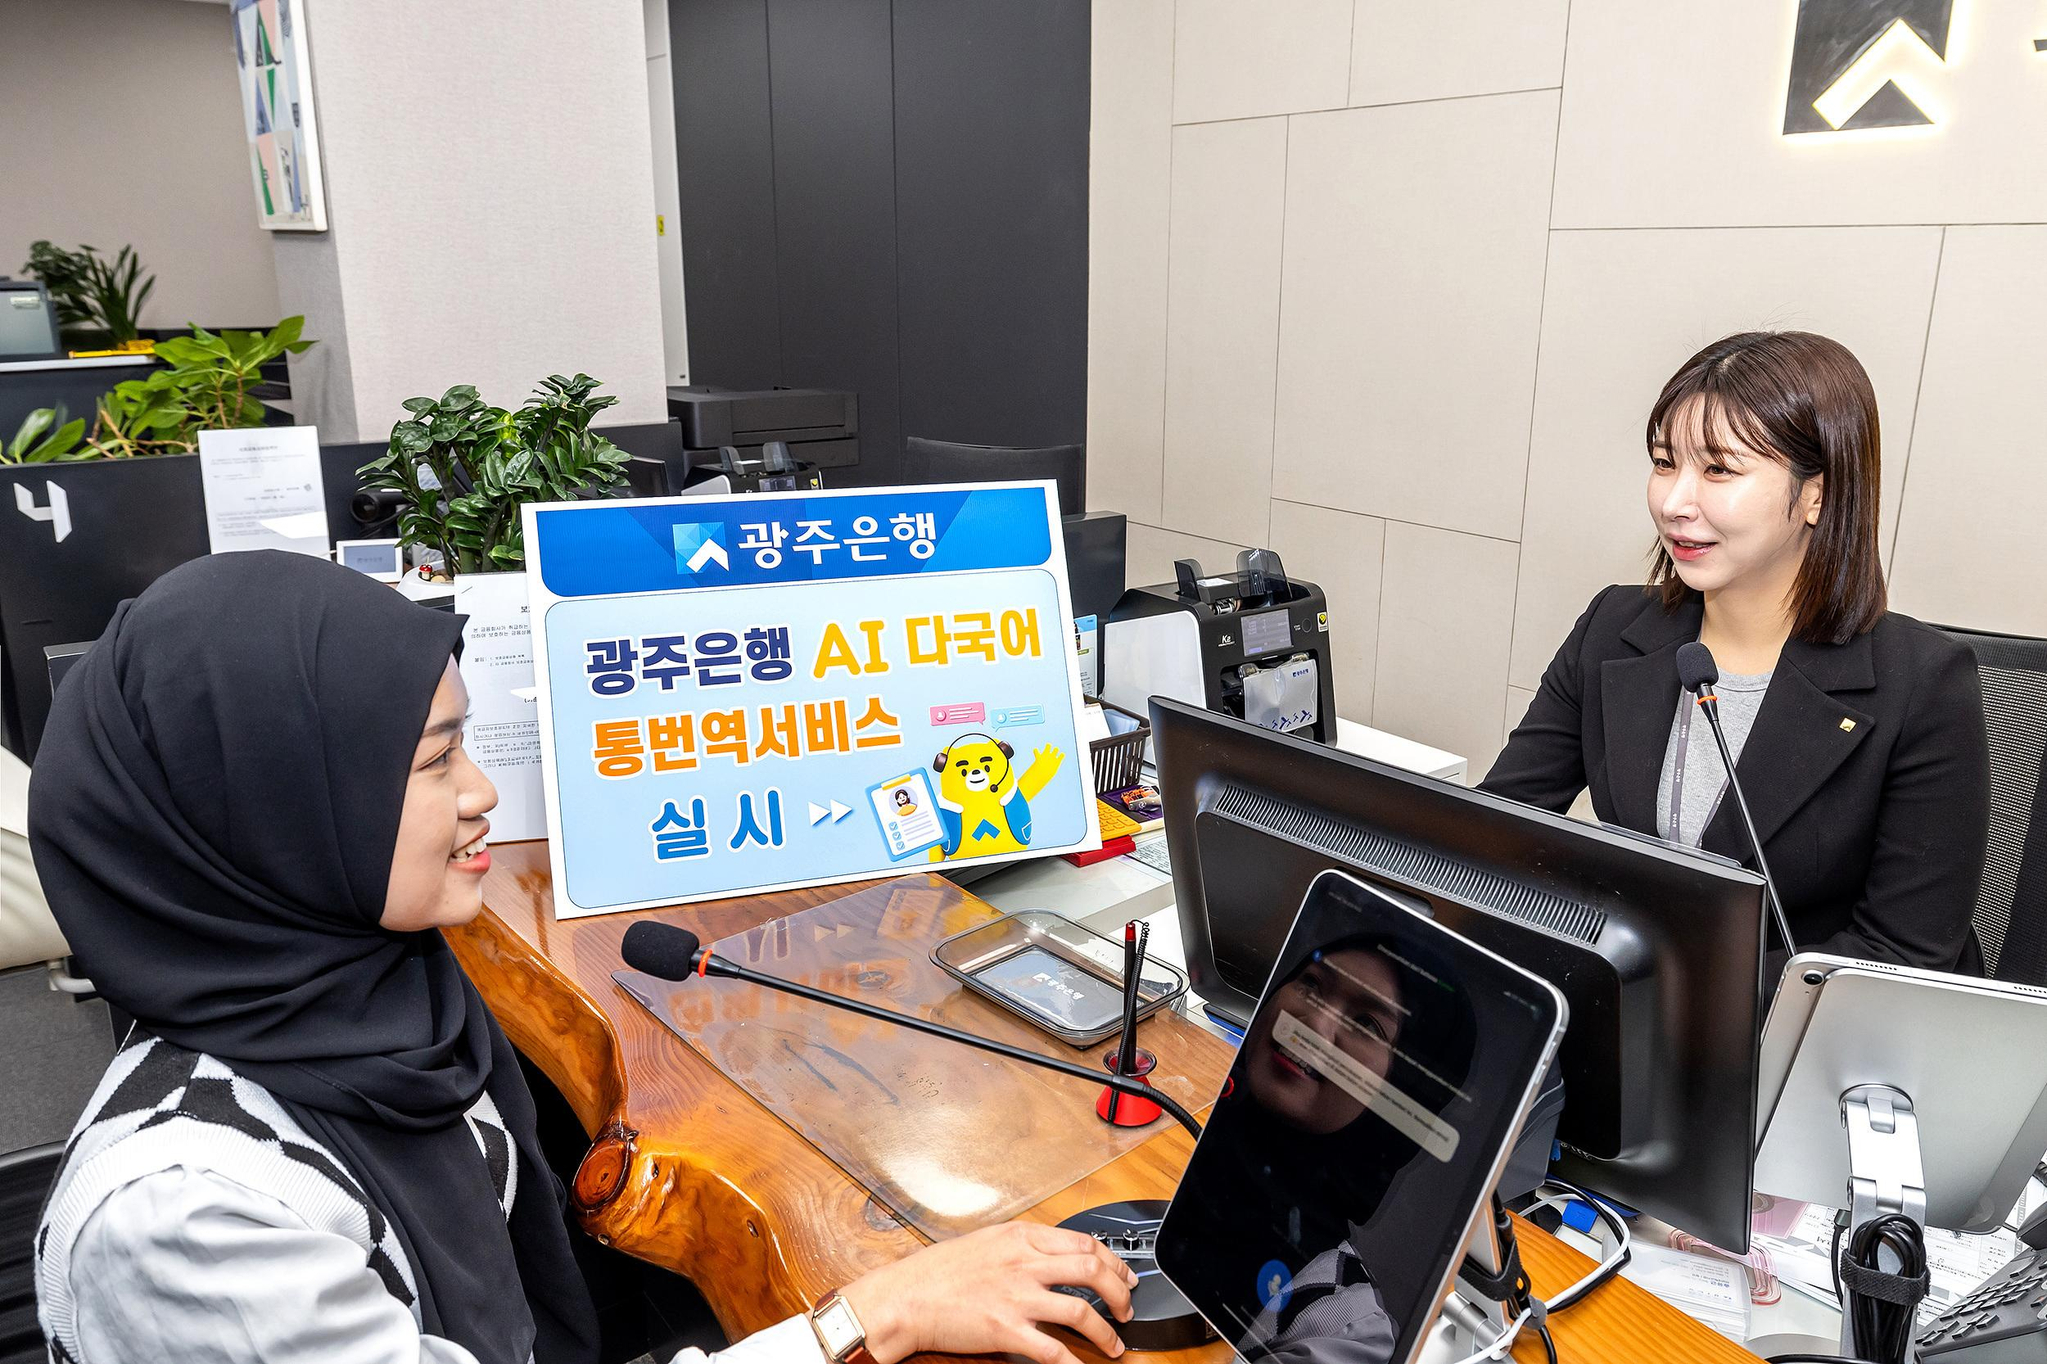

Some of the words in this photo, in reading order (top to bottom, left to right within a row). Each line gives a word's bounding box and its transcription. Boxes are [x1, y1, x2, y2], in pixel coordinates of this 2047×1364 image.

[13, 480, 72, 543] 4
[738, 512, 937, 570] 광주은행
[586, 626, 793, 695] 광주은행
[813, 620, 889, 679] AI
[905, 608, 1042, 665] 다국어
[593, 697, 902, 777] 통번역서비스
